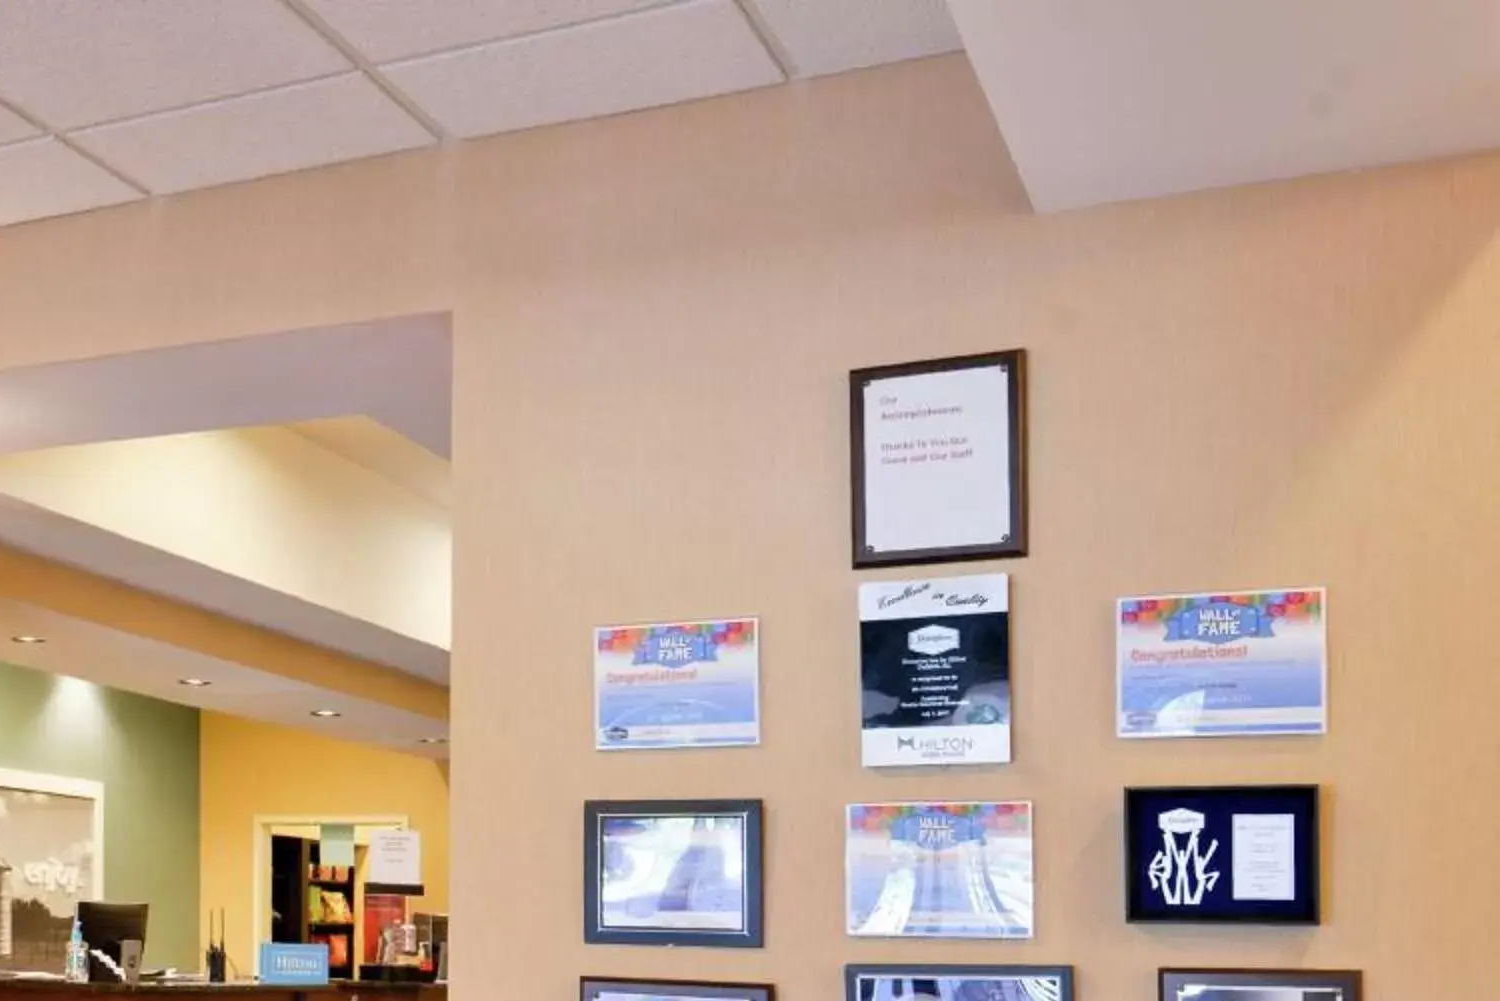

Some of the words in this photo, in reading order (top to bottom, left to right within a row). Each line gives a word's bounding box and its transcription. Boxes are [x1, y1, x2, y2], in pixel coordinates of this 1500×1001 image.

[1199, 608, 1232, 620] WALL
[1198, 620, 1241, 636] FAME
[659, 636, 686, 648] WALL
[658, 648, 693, 661] FAME
[918, 828, 957, 844] FAME
[275, 955, 318, 970] Hilton
